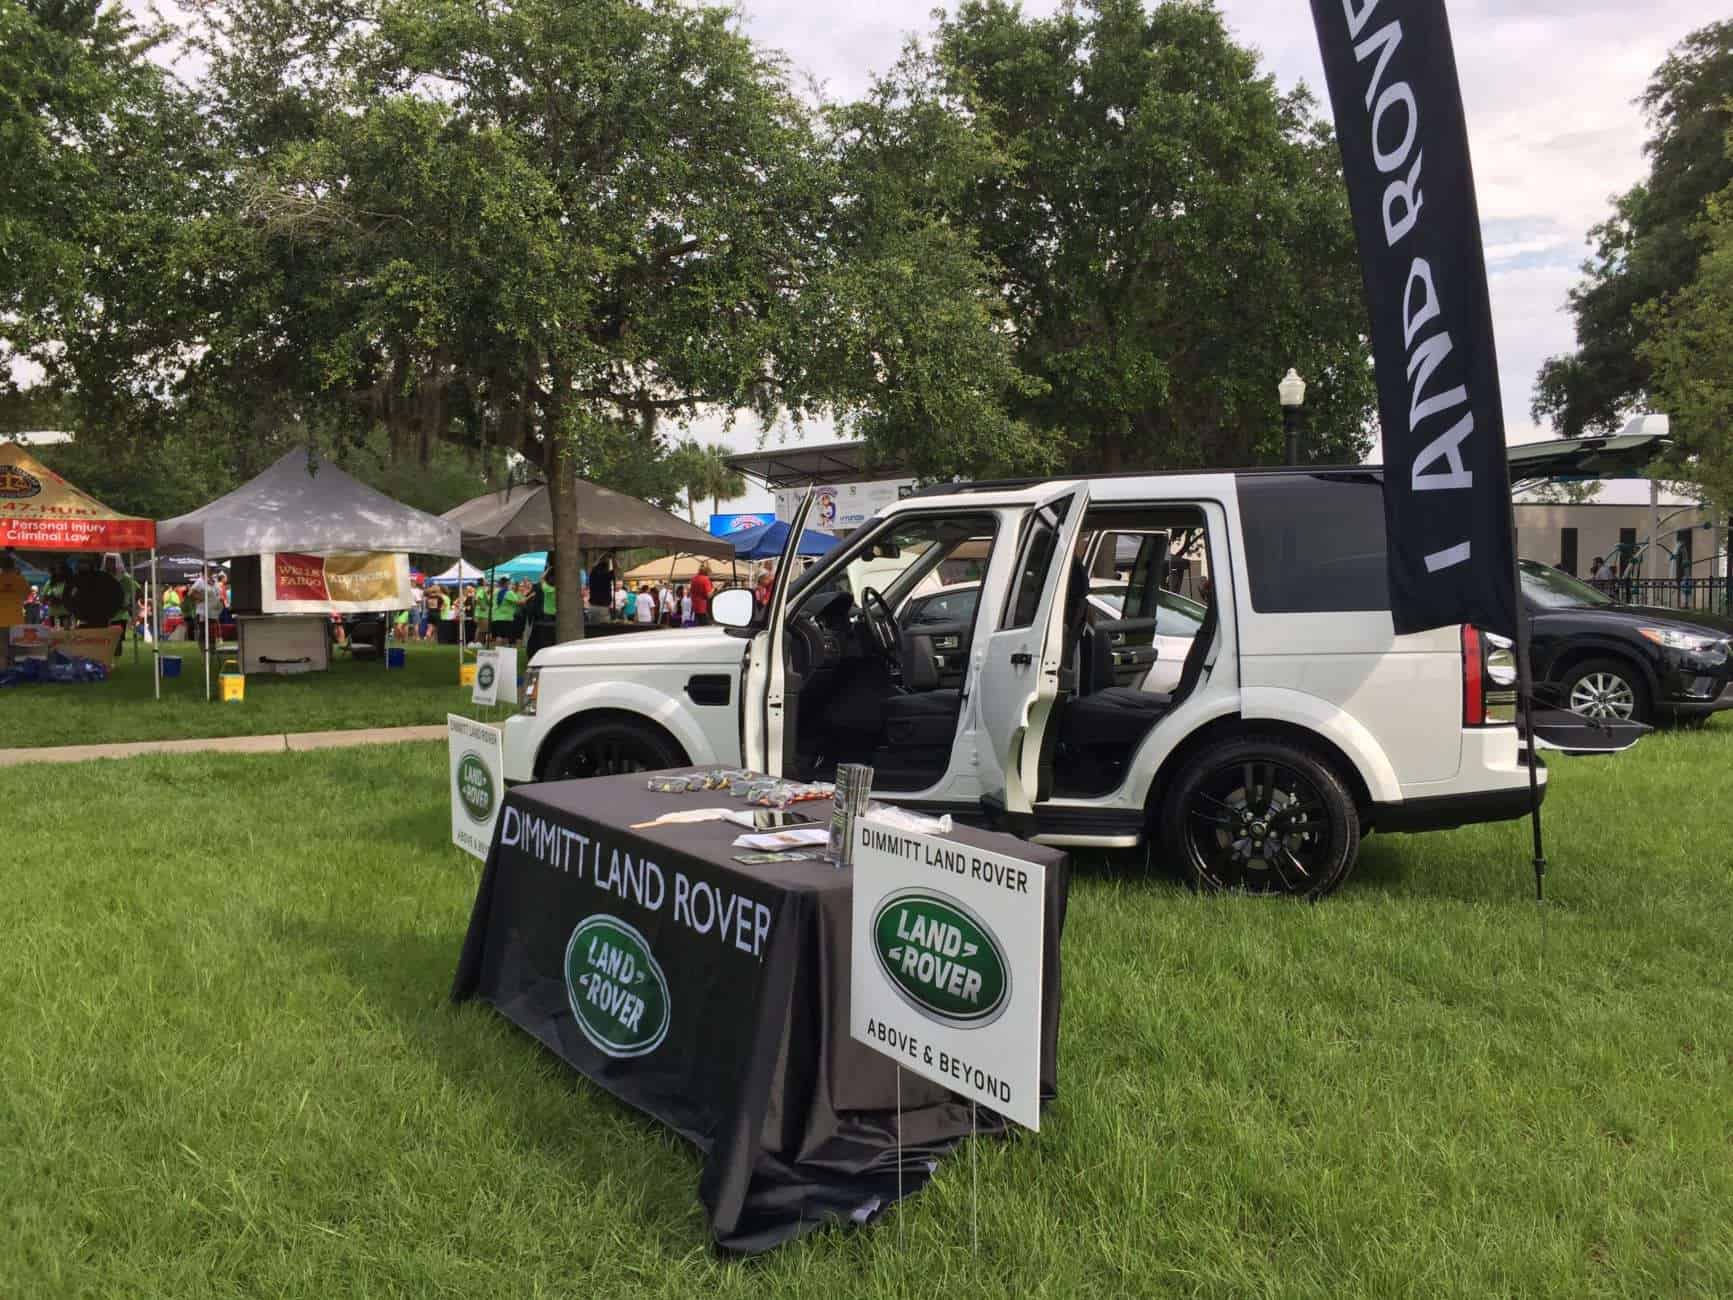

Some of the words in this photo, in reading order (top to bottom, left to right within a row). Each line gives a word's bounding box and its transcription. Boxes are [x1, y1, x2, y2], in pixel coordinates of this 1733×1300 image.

[6, 530, 61, 541] Criminal
[65, 532, 91, 542] Law
[12, 519, 68, 531] Personal
[71, 521, 106, 534] Injury
[280, 576, 322, 586] FARGO
[464, 763, 482, 786] LAND
[464, 784, 488, 807] ROVER
[501, 805, 590, 879] DIMMITT
[594, 842, 665, 911] LAND
[674, 872, 771, 960] ROVER
[862, 828, 921, 861] DIMMITT
[925, 845, 966, 875] LAND
[971, 858, 1028, 894] ROVER
[896, 908, 962, 958] LAND
[587, 935, 635, 984] LAND
[901, 945, 983, 1004] ROVER
[586, 972, 645, 1033] ROVER
[867, 1016, 917, 1058] ABOVE
[923, 1045, 933, 1065] &
[939, 1051, 1011, 1103] BEYOND
